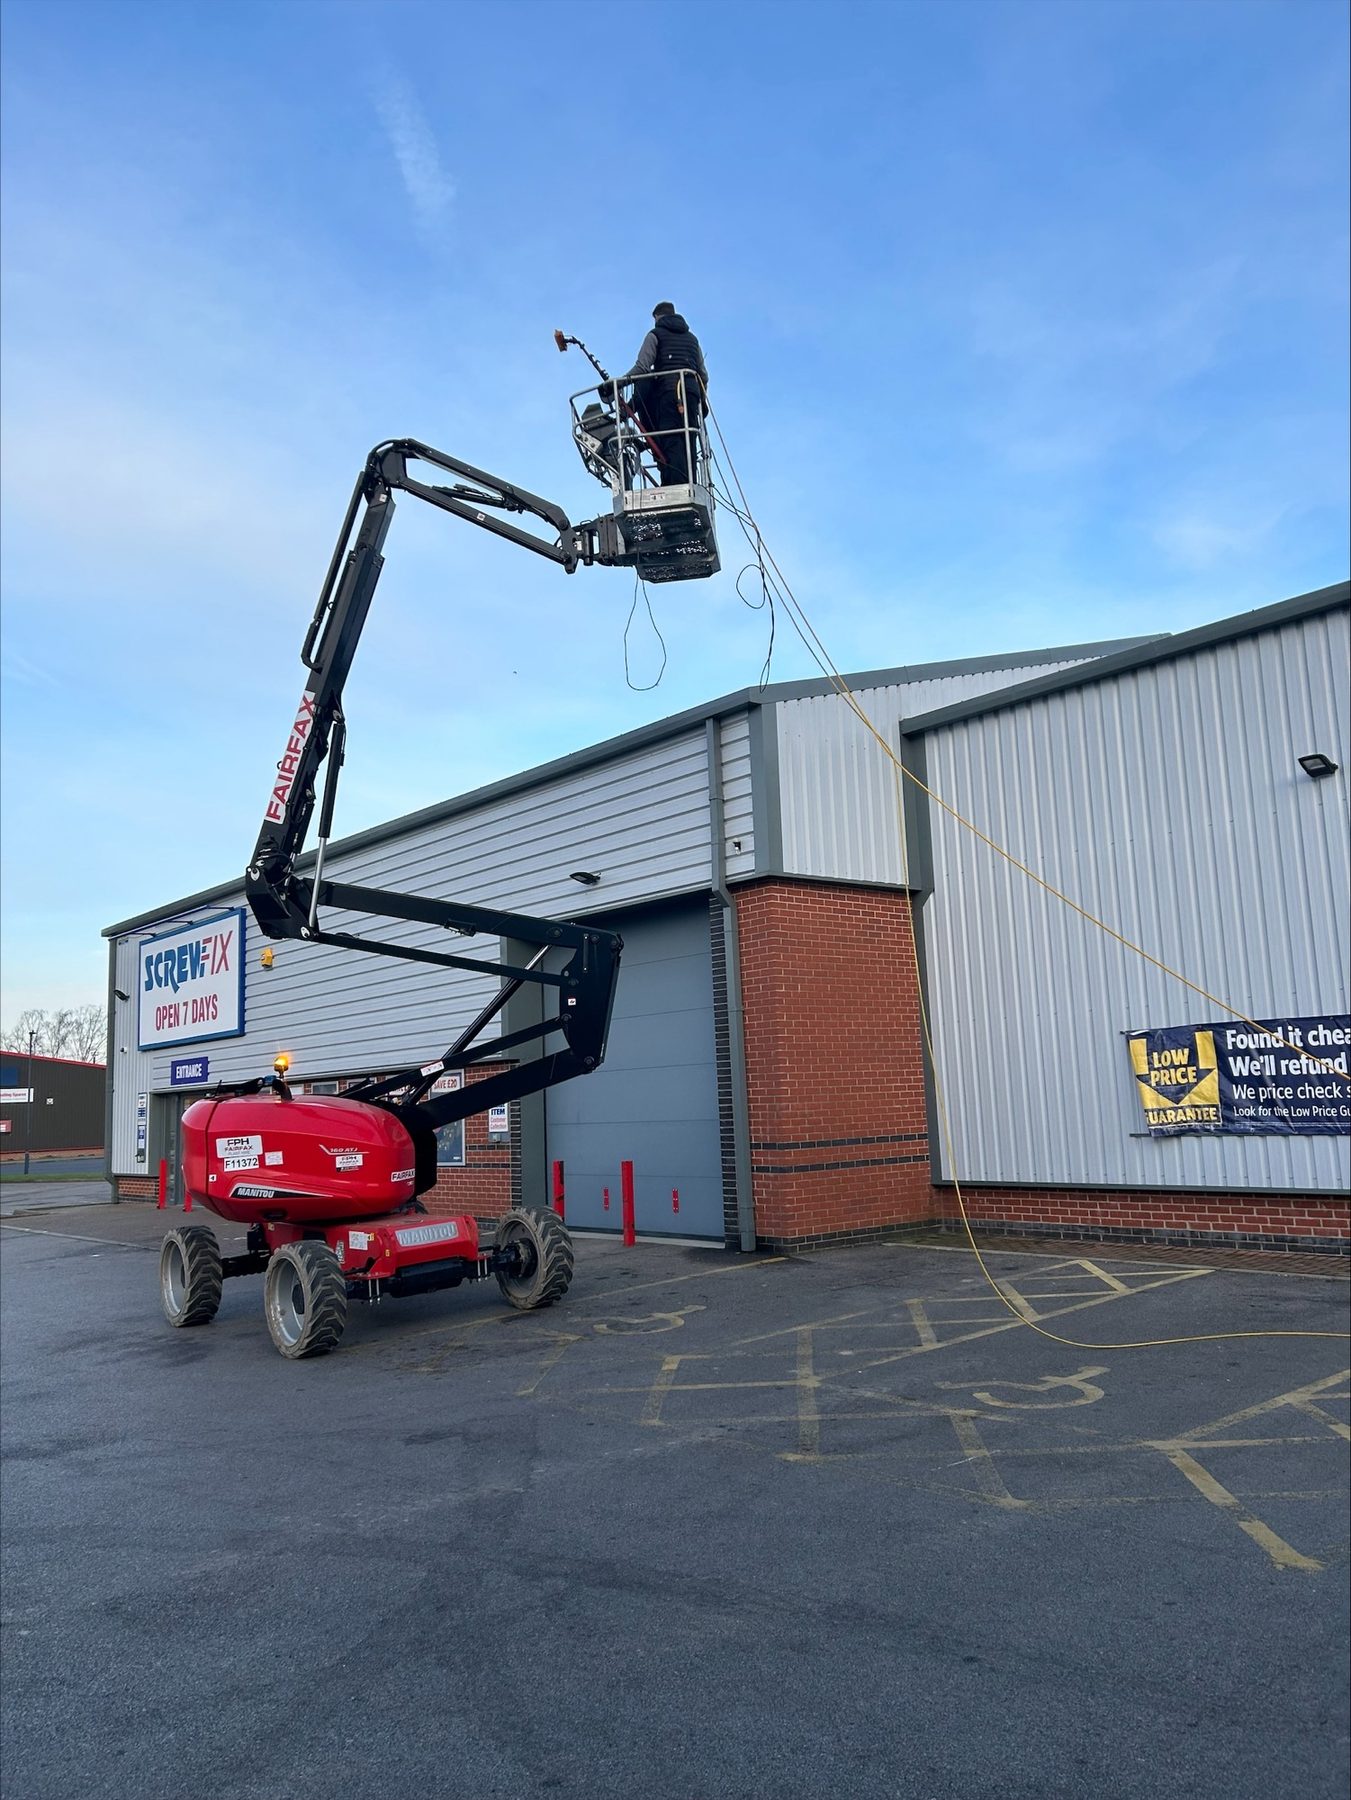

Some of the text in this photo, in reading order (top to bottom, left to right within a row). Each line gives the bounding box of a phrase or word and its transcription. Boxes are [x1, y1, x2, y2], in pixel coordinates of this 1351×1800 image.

[266, 694, 316, 821] FAIRFAX
[144, 930, 234, 994] SCREWFIX
[155, 993, 218, 1031] OPEN 7 DAYS
[1226, 1026, 1284, 1050] Found
[1288, 1025, 1303, 1047] it
[1152, 1048, 1189, 1068] LOW
[1228, 1051, 1348, 1077] We'll refund
[176, 1063, 203, 1079] ENTRANCE
[1150, 1066, 1197, 1087] PRICE
[1232, 1084, 1256, 1099] We
[1259, 1083, 1293, 1103] price
[1297, 1081, 1343, 1099] check
[490, 1108, 506, 1116] ITEM
[1145, 1107, 1218, 1125] UARANTEE
[1233, 1105, 1256, 1117] Look
[1258, 1105, 1271, 1117] for
[1274, 1105, 1289, 1117] the
[1291, 1105, 1312, 1117] Low
[1312, 1104, 1338, 1117] Price
[227, 1137, 250, 1147] FPH
[225, 1157, 259, 1169] F11372
[392, 1171, 415, 1181] FAIRFAX
[237, 1187, 275, 1199] MANITOU
[400, 1223, 457, 1246] MANITOU
